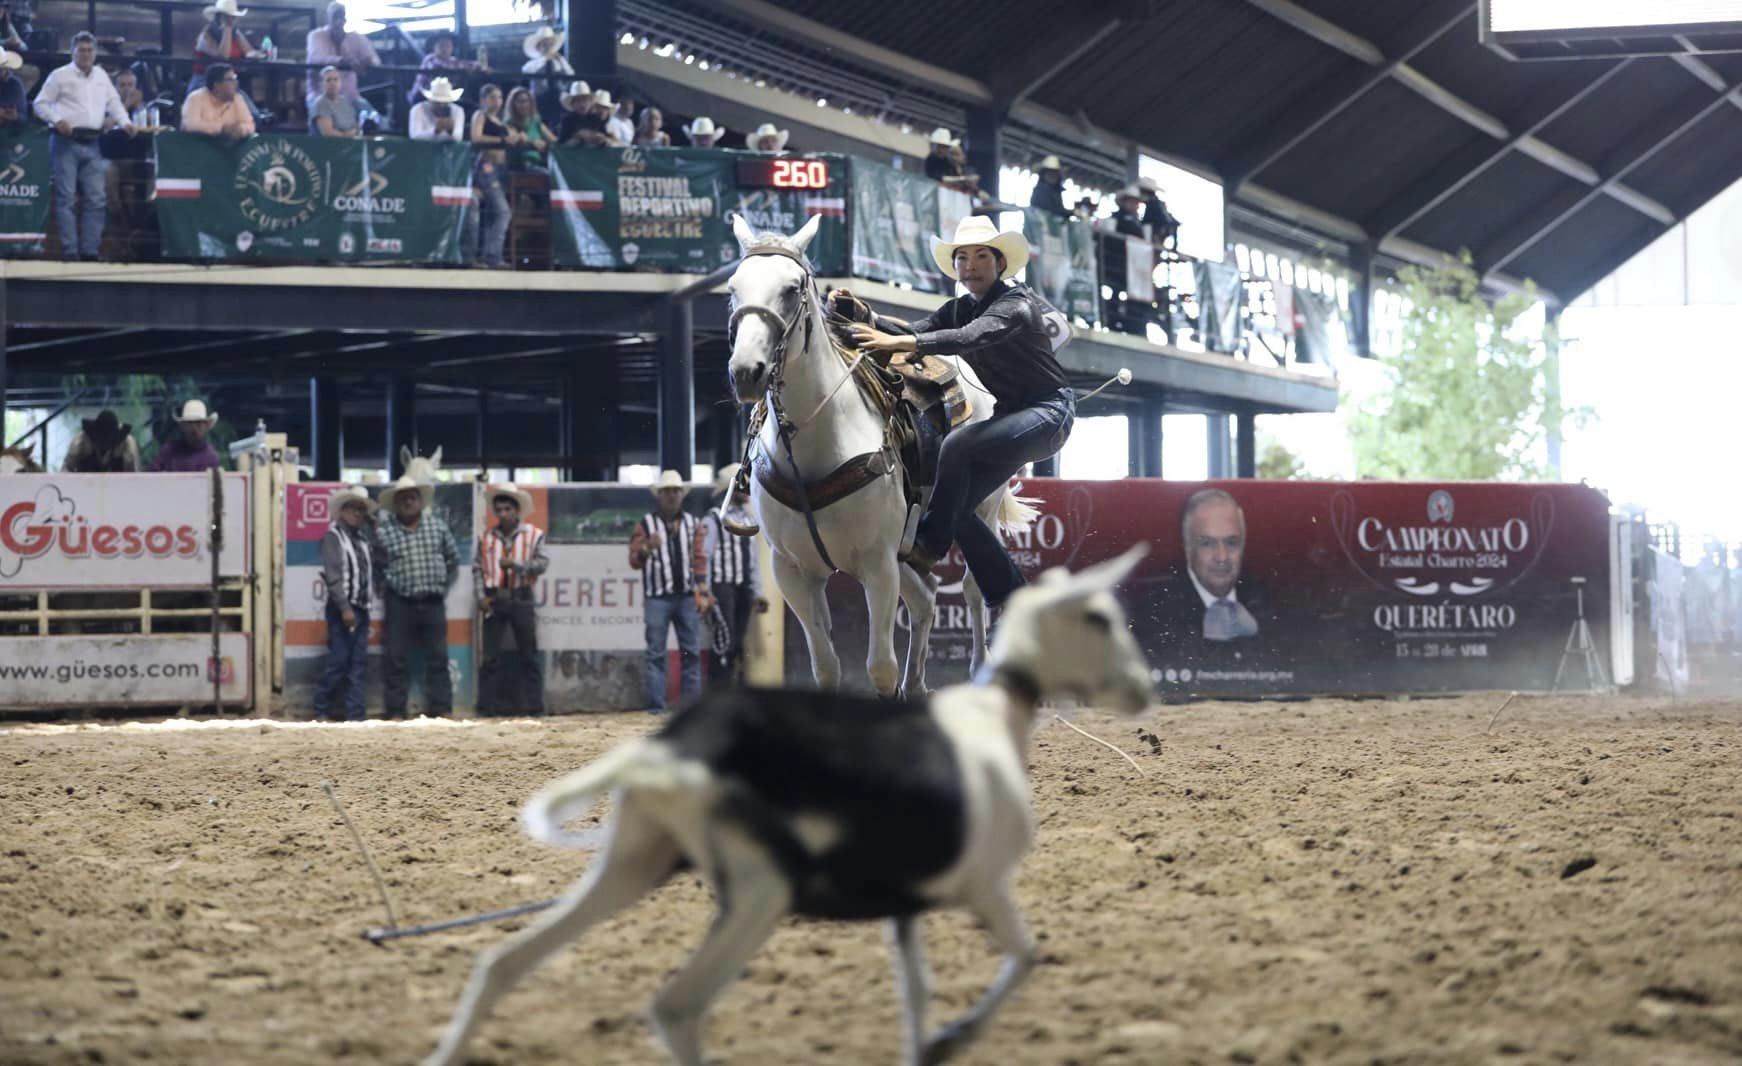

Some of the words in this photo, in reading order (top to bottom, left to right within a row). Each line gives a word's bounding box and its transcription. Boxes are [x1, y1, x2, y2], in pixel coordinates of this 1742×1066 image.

[773, 161, 826, 188] 260
[618, 176, 692, 197] FESTIVAL
[333, 196, 405, 213] CONADE
[619, 197, 713, 217] DEPORTIVO
[723, 209, 795, 229] CNADE
[0, 501, 197, 556] Güesos
[1358, 516, 1529, 552] CAMPEONATO
[1427, 554, 1475, 568] Charro
[1476, 554, 1507, 568] 2024
[591, 615, 644, 625] ENCONT
[1374, 599, 1516, 631] QUERÉTARO
